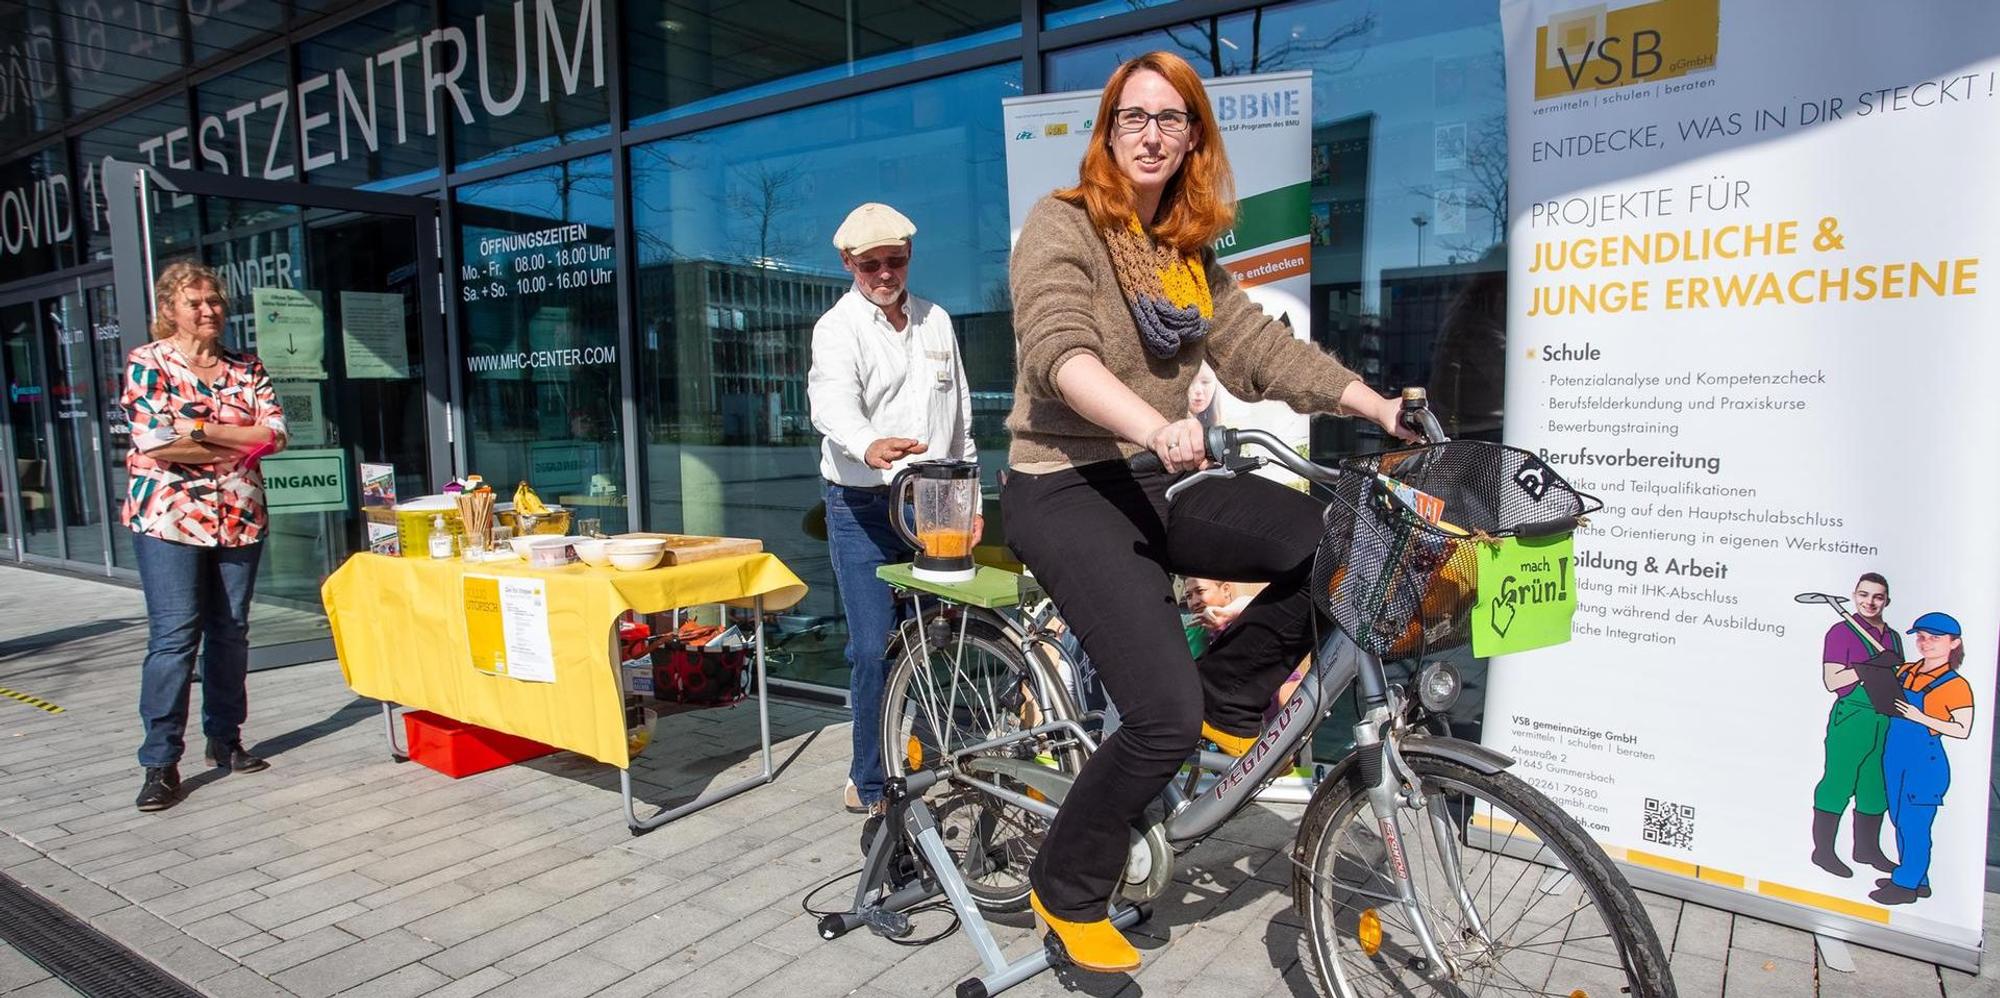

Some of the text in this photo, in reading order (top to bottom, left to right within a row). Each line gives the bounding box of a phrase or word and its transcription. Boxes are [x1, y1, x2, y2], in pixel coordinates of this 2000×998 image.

[1557, 30, 1663, 90] VSB
[1669, 54, 1713, 72] gGmbH
[1218, 90, 1300, 121] BBNE
[1533, 99, 1589, 116] vermitteln
[1602, 90, 1650, 105] schulen
[1665, 78, 1716, 95] beraten
[0, 174, 72, 255] OVID
[138, 0, 605, 213] TESTZENTRUM
[1285, 119, 1300, 127] BMU
[1532, 126, 1665, 162] ENTDECKE,
[1679, 113, 1742, 142] WAS
[1754, 106, 1785, 132] IN
[1800, 97, 1843, 126] DIR
[1857, 74, 1980, 117] STECKT
[1531, 175, 1751, 229] PROJEKTE FÜR
[480, 223, 587, 257] ÖFFNUNGSZEITEN
[1215, 229, 1236, 250] nd
[1528, 217, 1846, 273] JUGENDLICHE &
[462, 265, 481, 281] Mo.
[489, 261, 503, 277] Fr.
[515, 253, 545, 273] 08.00
[555, 246, 587, 267] 18.00
[589, 244, 612, 262] Uhr
[1246, 257, 1304, 278] entdecken
[463, 286, 480, 302] Sa.
[490, 282, 508, 298] So.
[517, 276, 546, 294] 10.00
[556, 270, 588, 289] 16.00
[590, 268, 613, 285] Uhr
[1527, 258, 1980, 318] JUNGE ERWACHSENE
[230, 312, 257, 349] TE
[467, 346, 615, 372] WWW.MHC-CENTER.COM
[1542, 343, 1601, 362] Schule
[1549, 370, 1826, 388] Potenzialanalyse und Kompetenzcheck
[1549, 396, 1806, 412] Berufsfelderkundung und Praxiskurse
[1548, 420, 1679, 437] Bewerbungstraining
[1539, 448, 1721, 474] Berufsvorbereitung
[1601, 479, 1625, 491] und
[1630, 480, 1757, 498] Teilqualifikationen
[1630, 503, 1653, 517] auf
[1658, 503, 1683, 517] den
[1689, 507, 1844, 528] Hauptschulabschluss
[1611, 525, 1697, 545] Orientierung
[1701, 531, 1715, 543] in
[1720, 535, 1779, 550] eigenen
[1785, 536, 1879, 556] Werkstätten
[1520, 557, 1551, 573] mach
[1644, 556, 1659, 573] &
[1665, 559, 1728, 580] Arbeit
[1501, 557, 1568, 605] Grün!
[1618, 584, 1637, 595] mit
[1642, 584, 1738, 606] IHK-Abschluss
[1612, 606, 1671, 624] während
[1675, 609, 1698, 625] der
[1703, 613, 1785, 637] Ausbildung
[1606, 625, 1677, 646] Integration
[1512, 715, 1638, 745] VSB gemeinnützige GmbH
[1215, 696, 1303, 800] PEGASUS
[1511, 729, 1555, 743] vermitteln
[1567, 738, 1603, 751] schulen
[1616, 744, 1656, 761] beraten
[1560, 753, 1567, 763] 2
[1546, 763, 1615, 785] Gummersbach
[1528, 777, 1598, 799] 02261 79580
